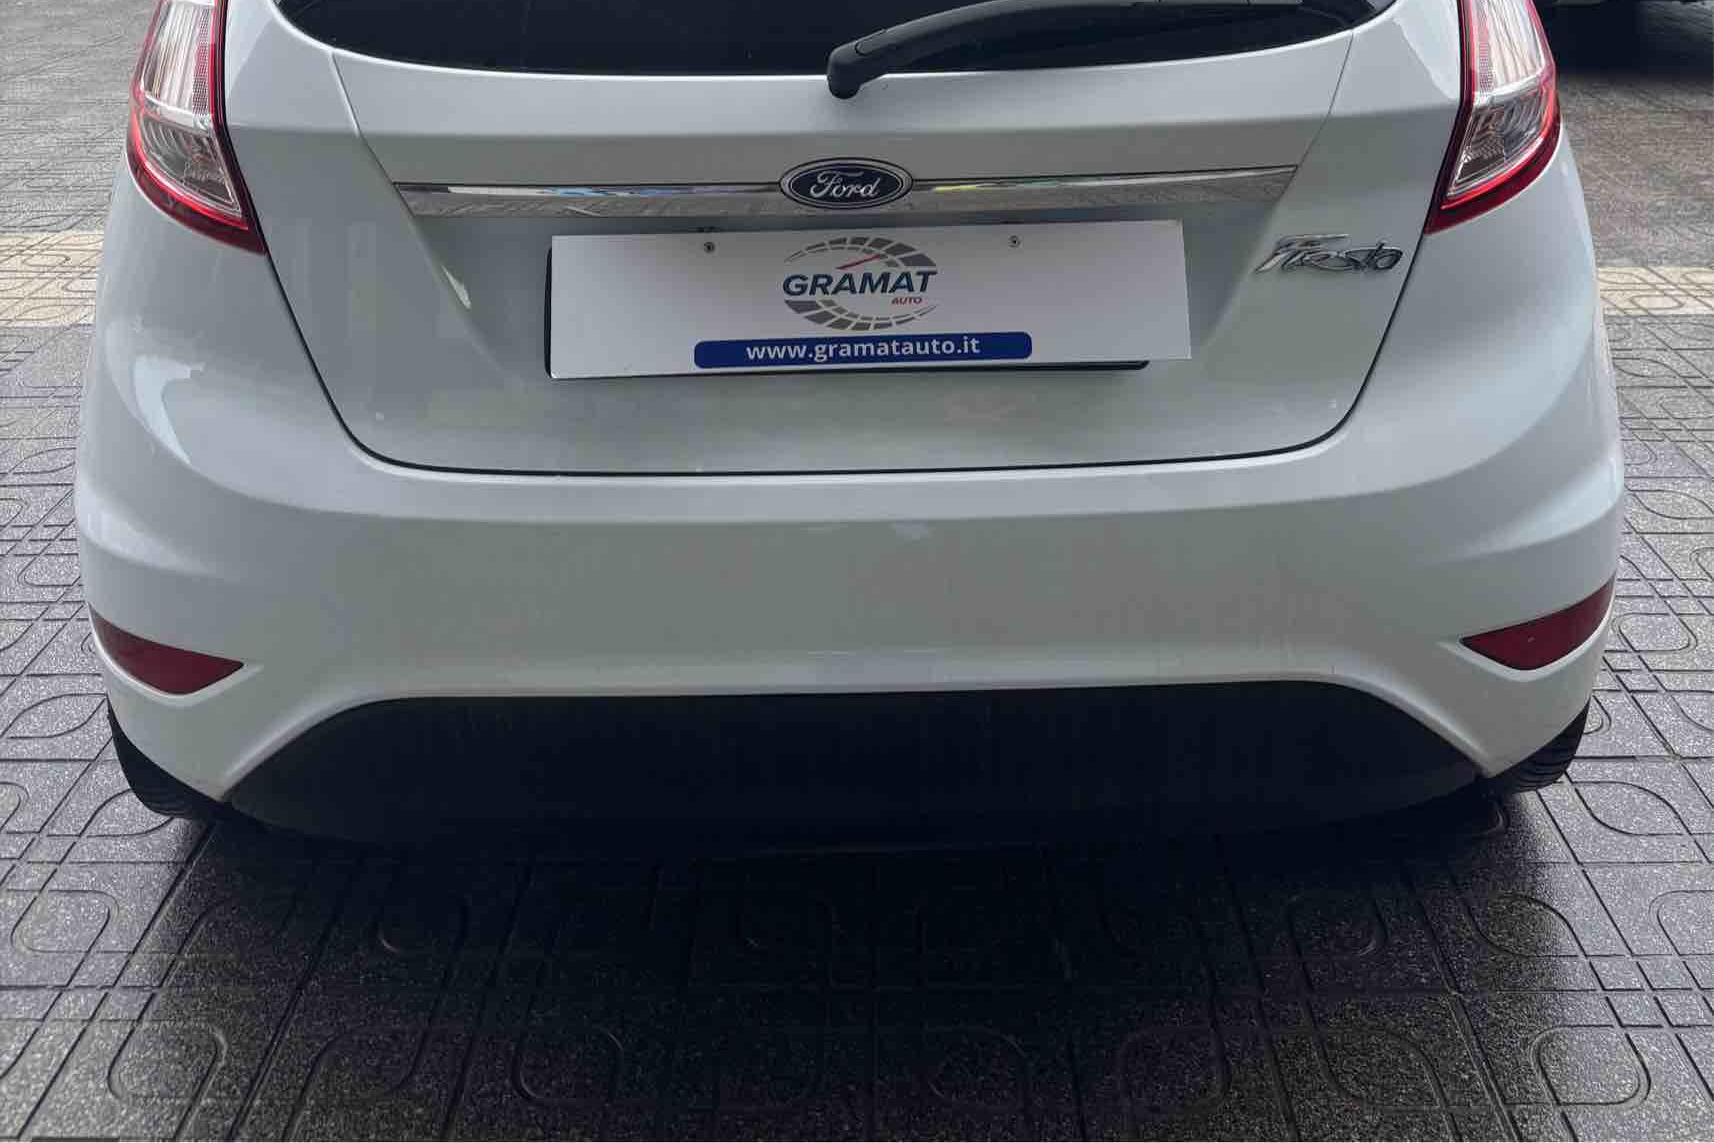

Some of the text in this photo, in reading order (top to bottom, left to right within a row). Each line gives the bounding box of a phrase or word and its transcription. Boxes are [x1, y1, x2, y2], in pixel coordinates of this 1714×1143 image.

[809, 170, 881, 198] Ford
[782, 269, 939, 297] GRAMAT
[891, 296, 923, 306] AUTO
[745, 335, 981, 363] www.gramatauto.it
